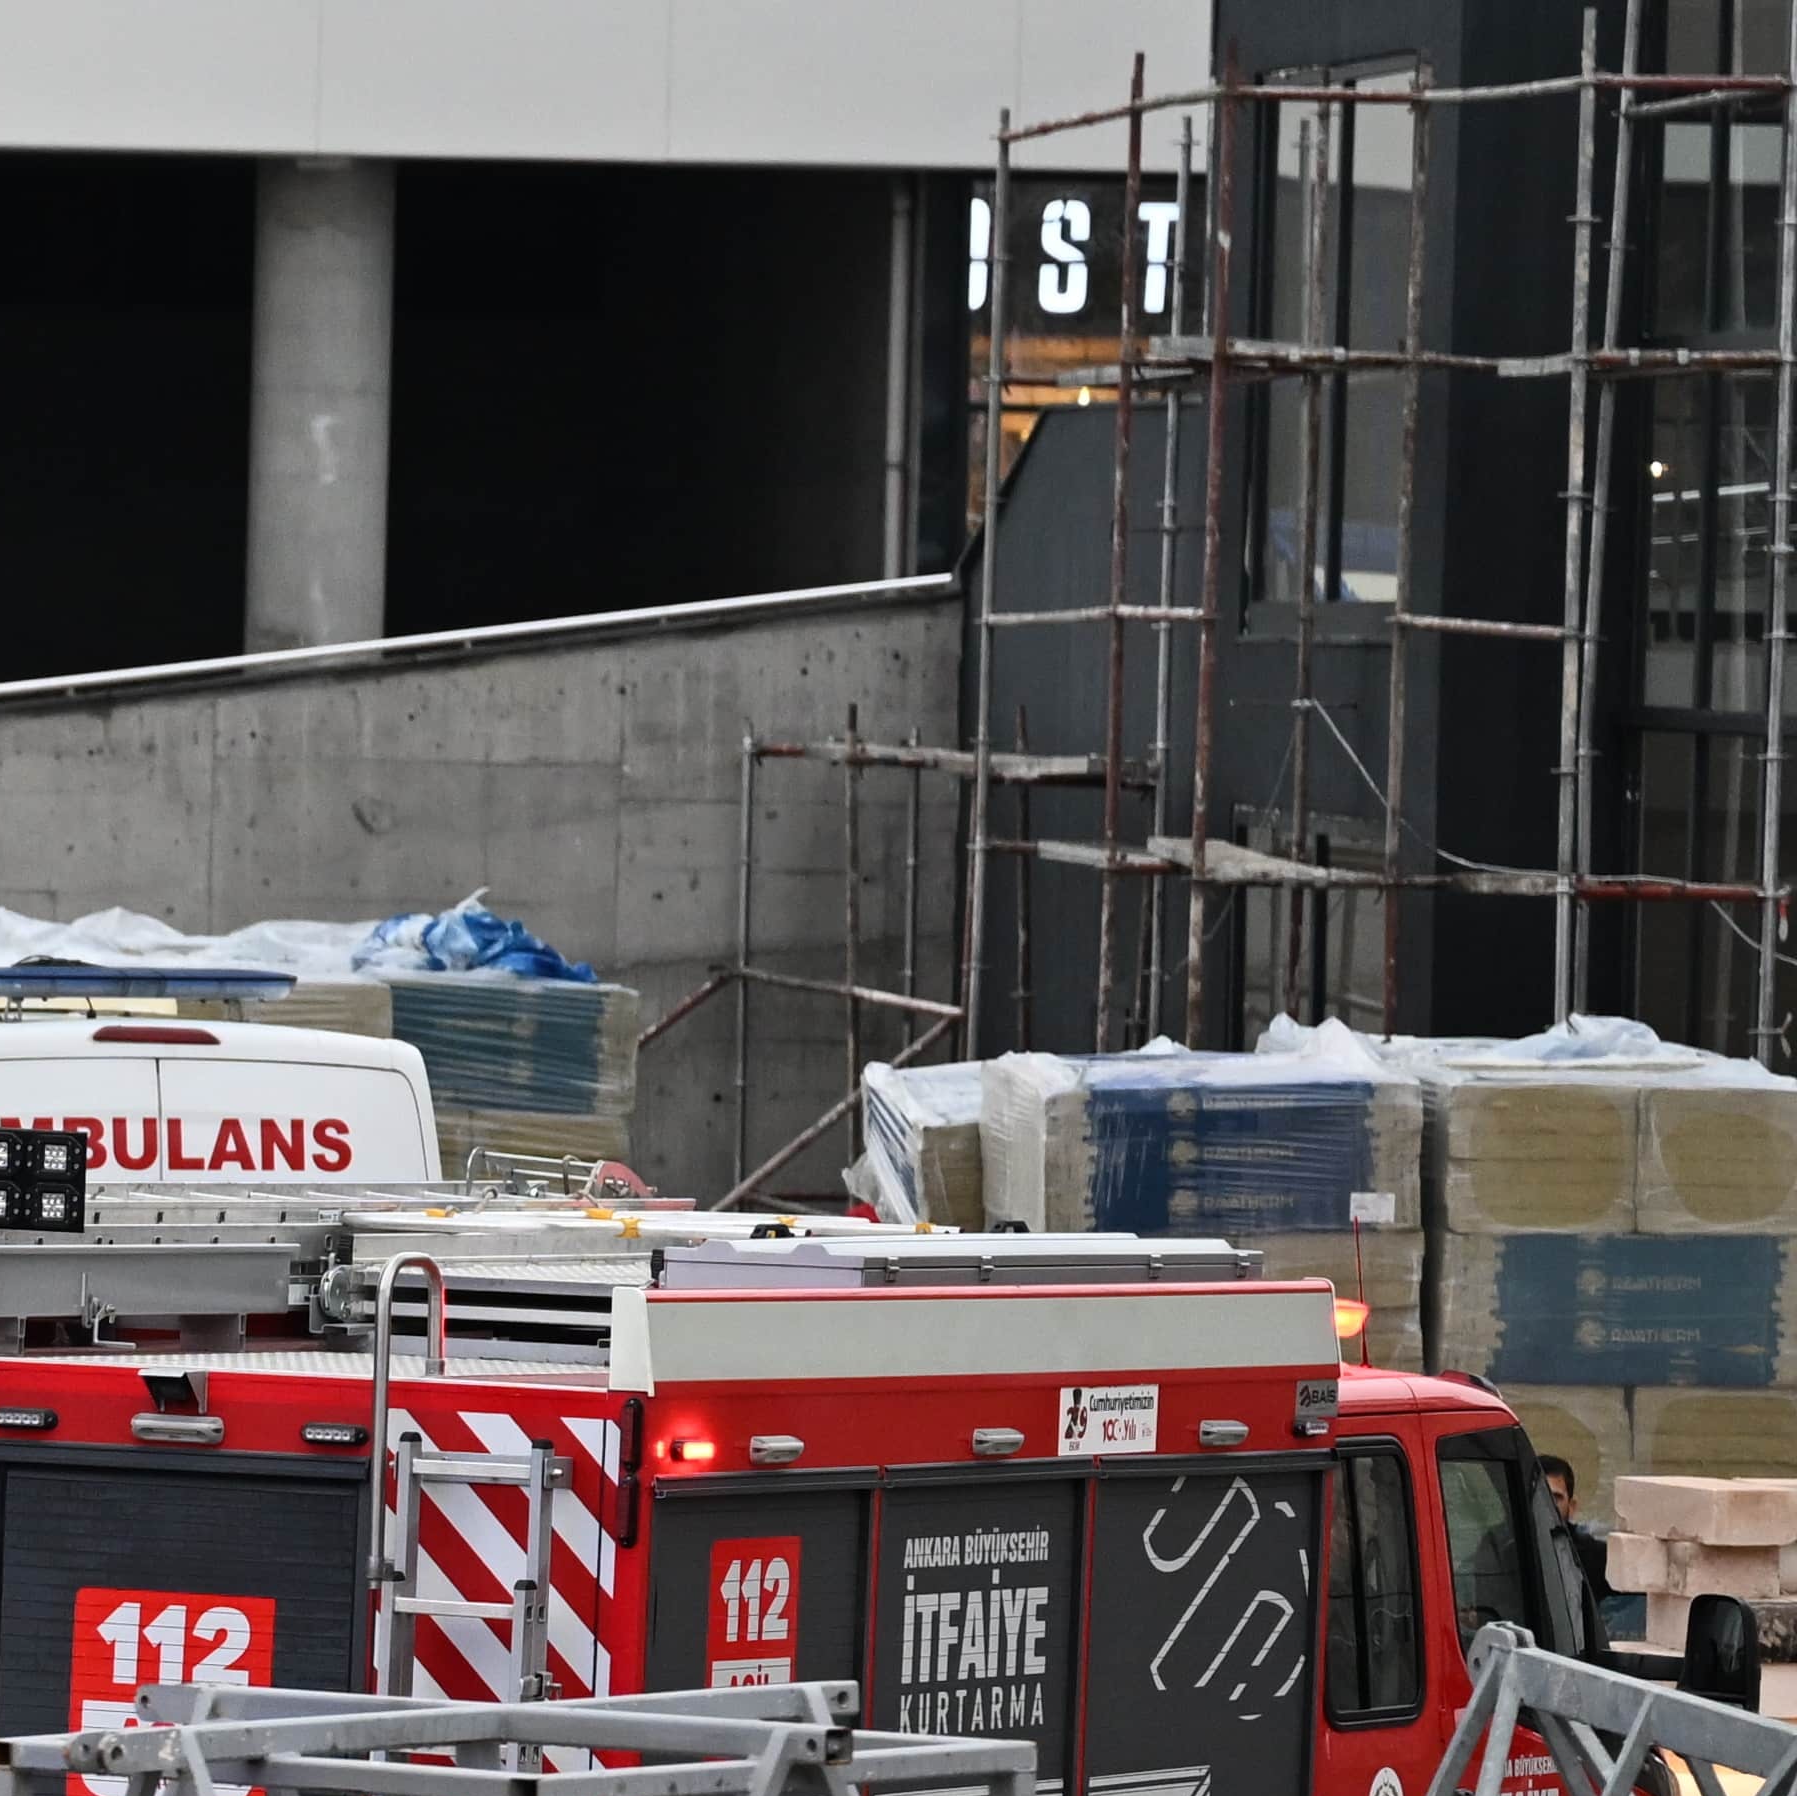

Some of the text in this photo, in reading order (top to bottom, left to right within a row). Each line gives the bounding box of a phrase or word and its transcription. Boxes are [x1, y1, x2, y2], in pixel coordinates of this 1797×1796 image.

[1090, 1392, 1155, 1415] Cumhuriyetimizin
[904, 1535, 961, 1568] ANKARA
[720, 1557, 790, 1643] 112
[900, 1569, 1049, 1684] İTFAİYE
[97, 1602, 251, 1686] 112
[900, 1683, 1044, 1734] KURTARMA
